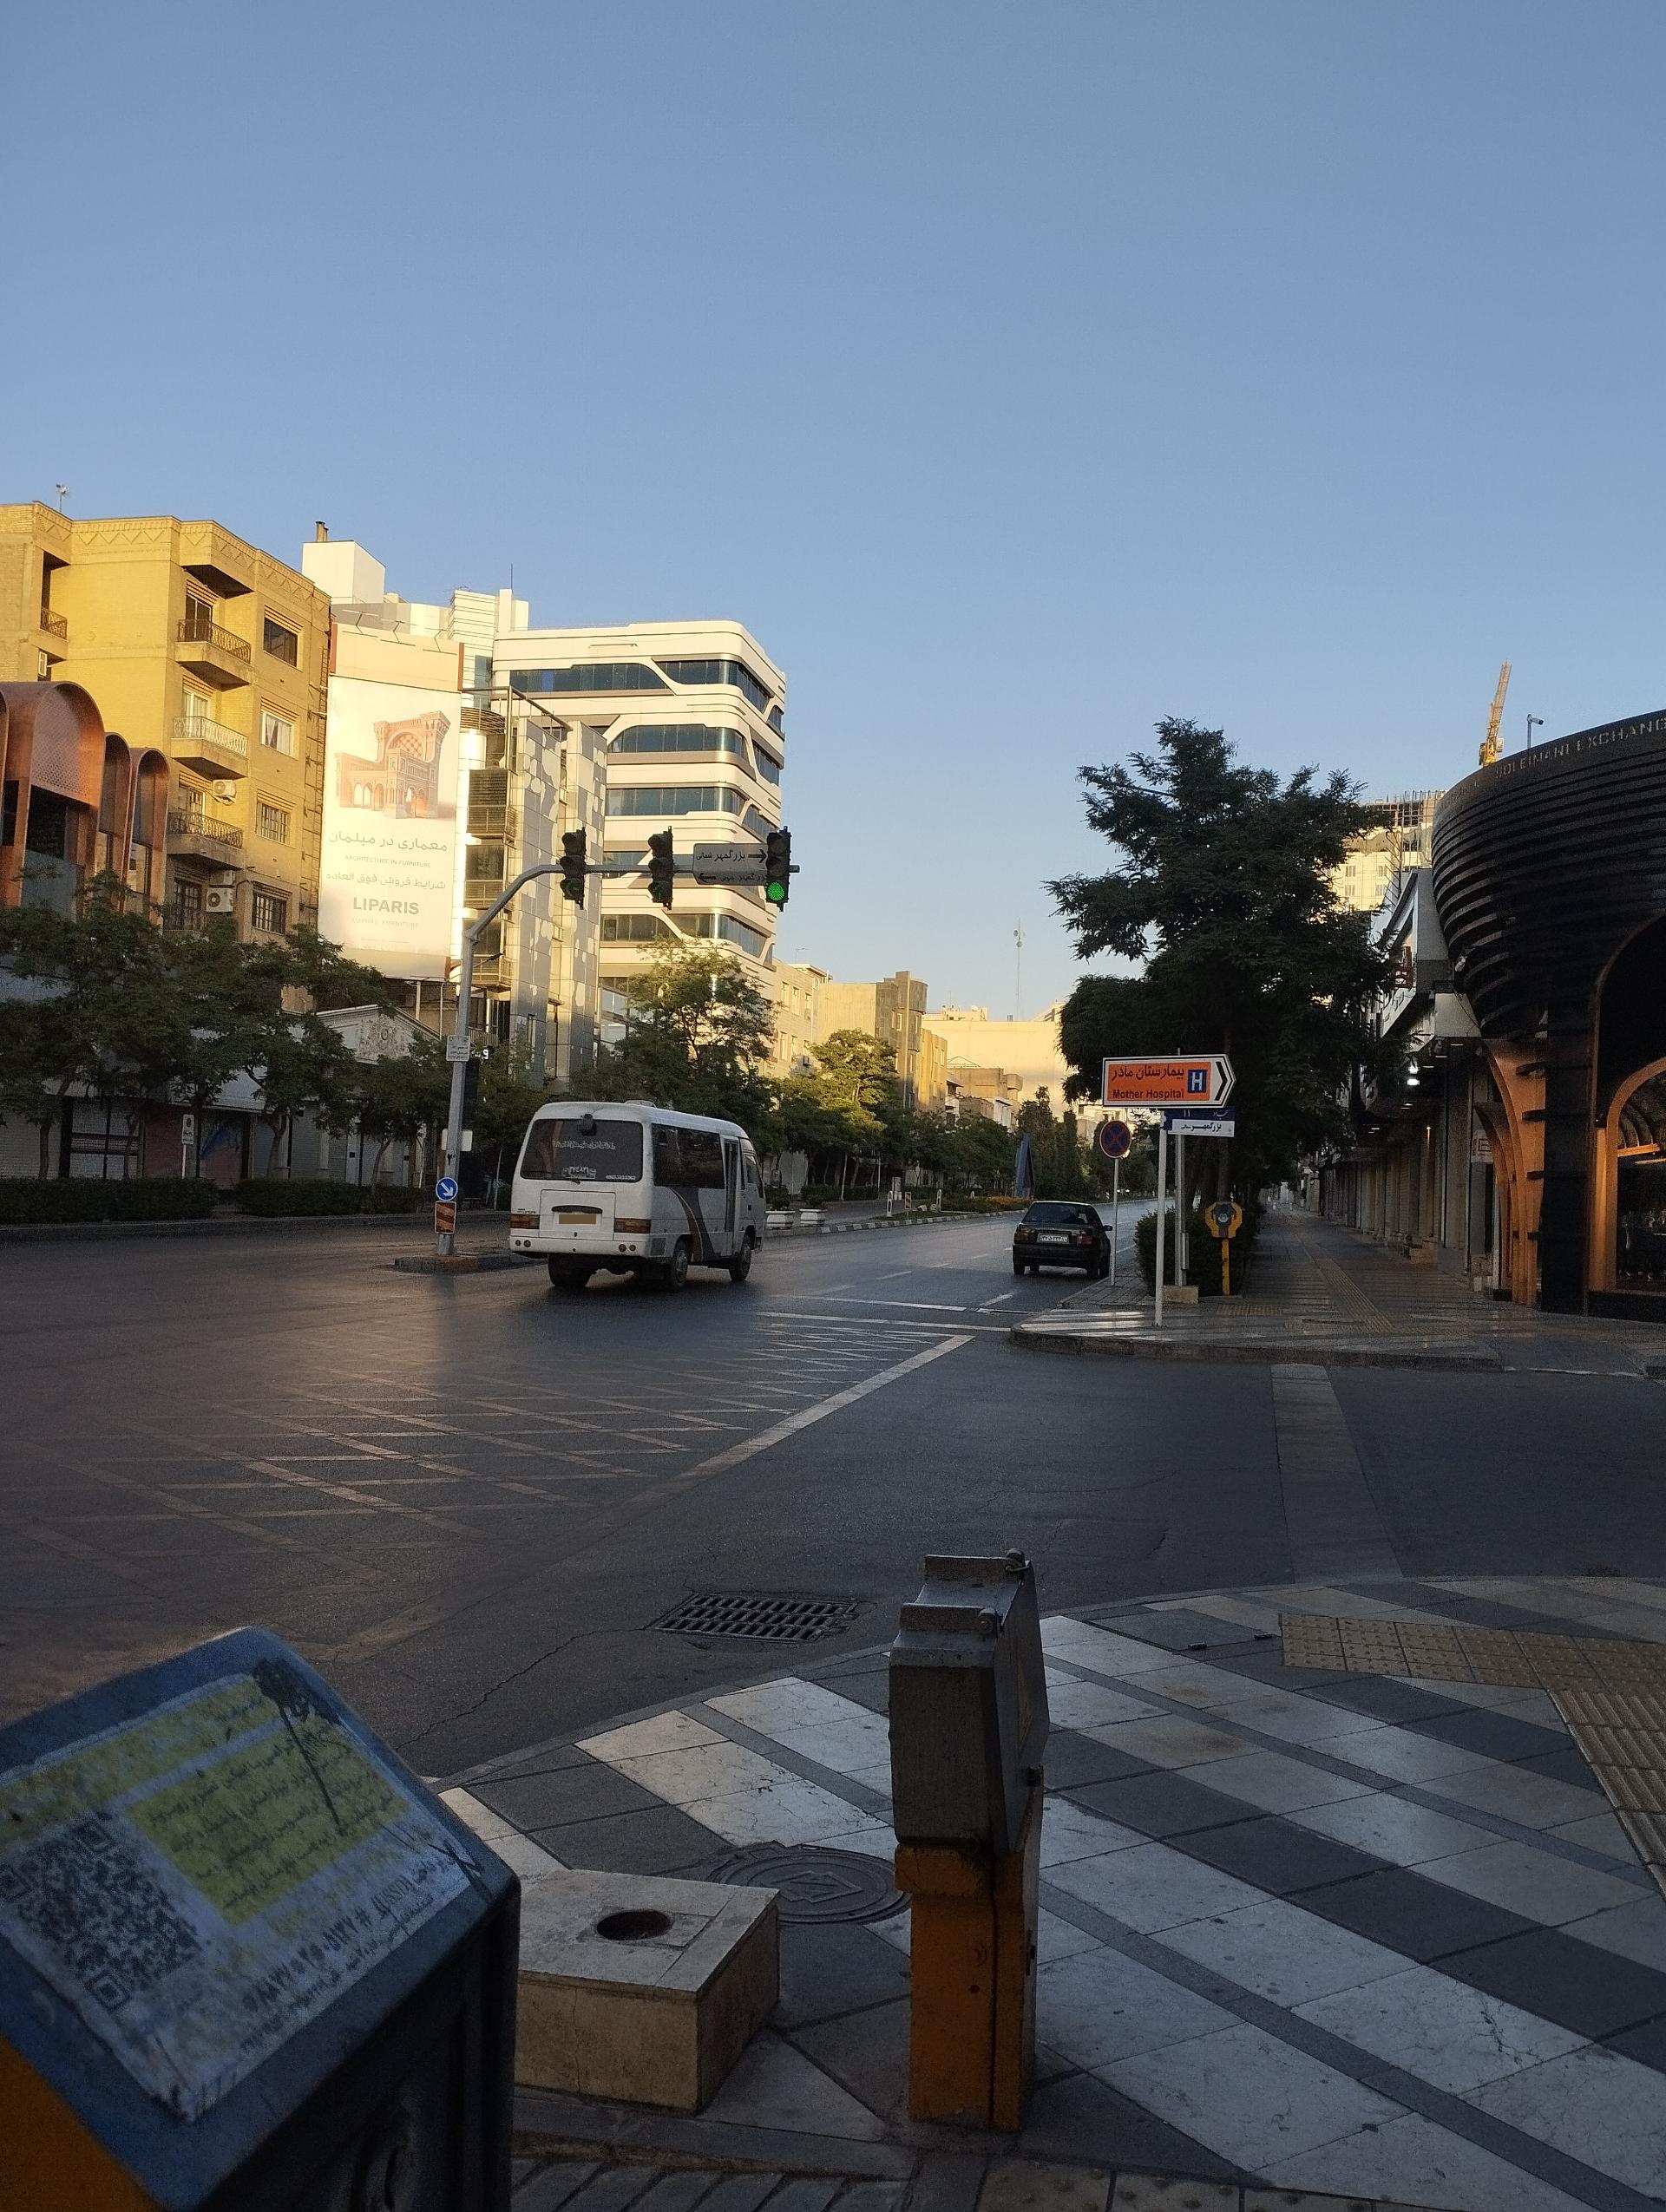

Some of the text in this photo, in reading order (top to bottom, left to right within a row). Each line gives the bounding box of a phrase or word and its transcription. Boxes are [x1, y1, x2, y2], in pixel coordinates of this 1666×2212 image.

[329, 831, 448, 852] معماری در مبلمان
[398, 860, 431, 868] FURNITURE
[357, 874, 377, 884] فوق
[380, 876, 411, 887] فروش
[414, 879, 446, 891] شرایط
[352, 897, 420, 915] LIPARIS
[1112, 1063, 1184, 1081] بیمارستان مادر
[1112, 1089, 1184, 1101] Mother Hospital
